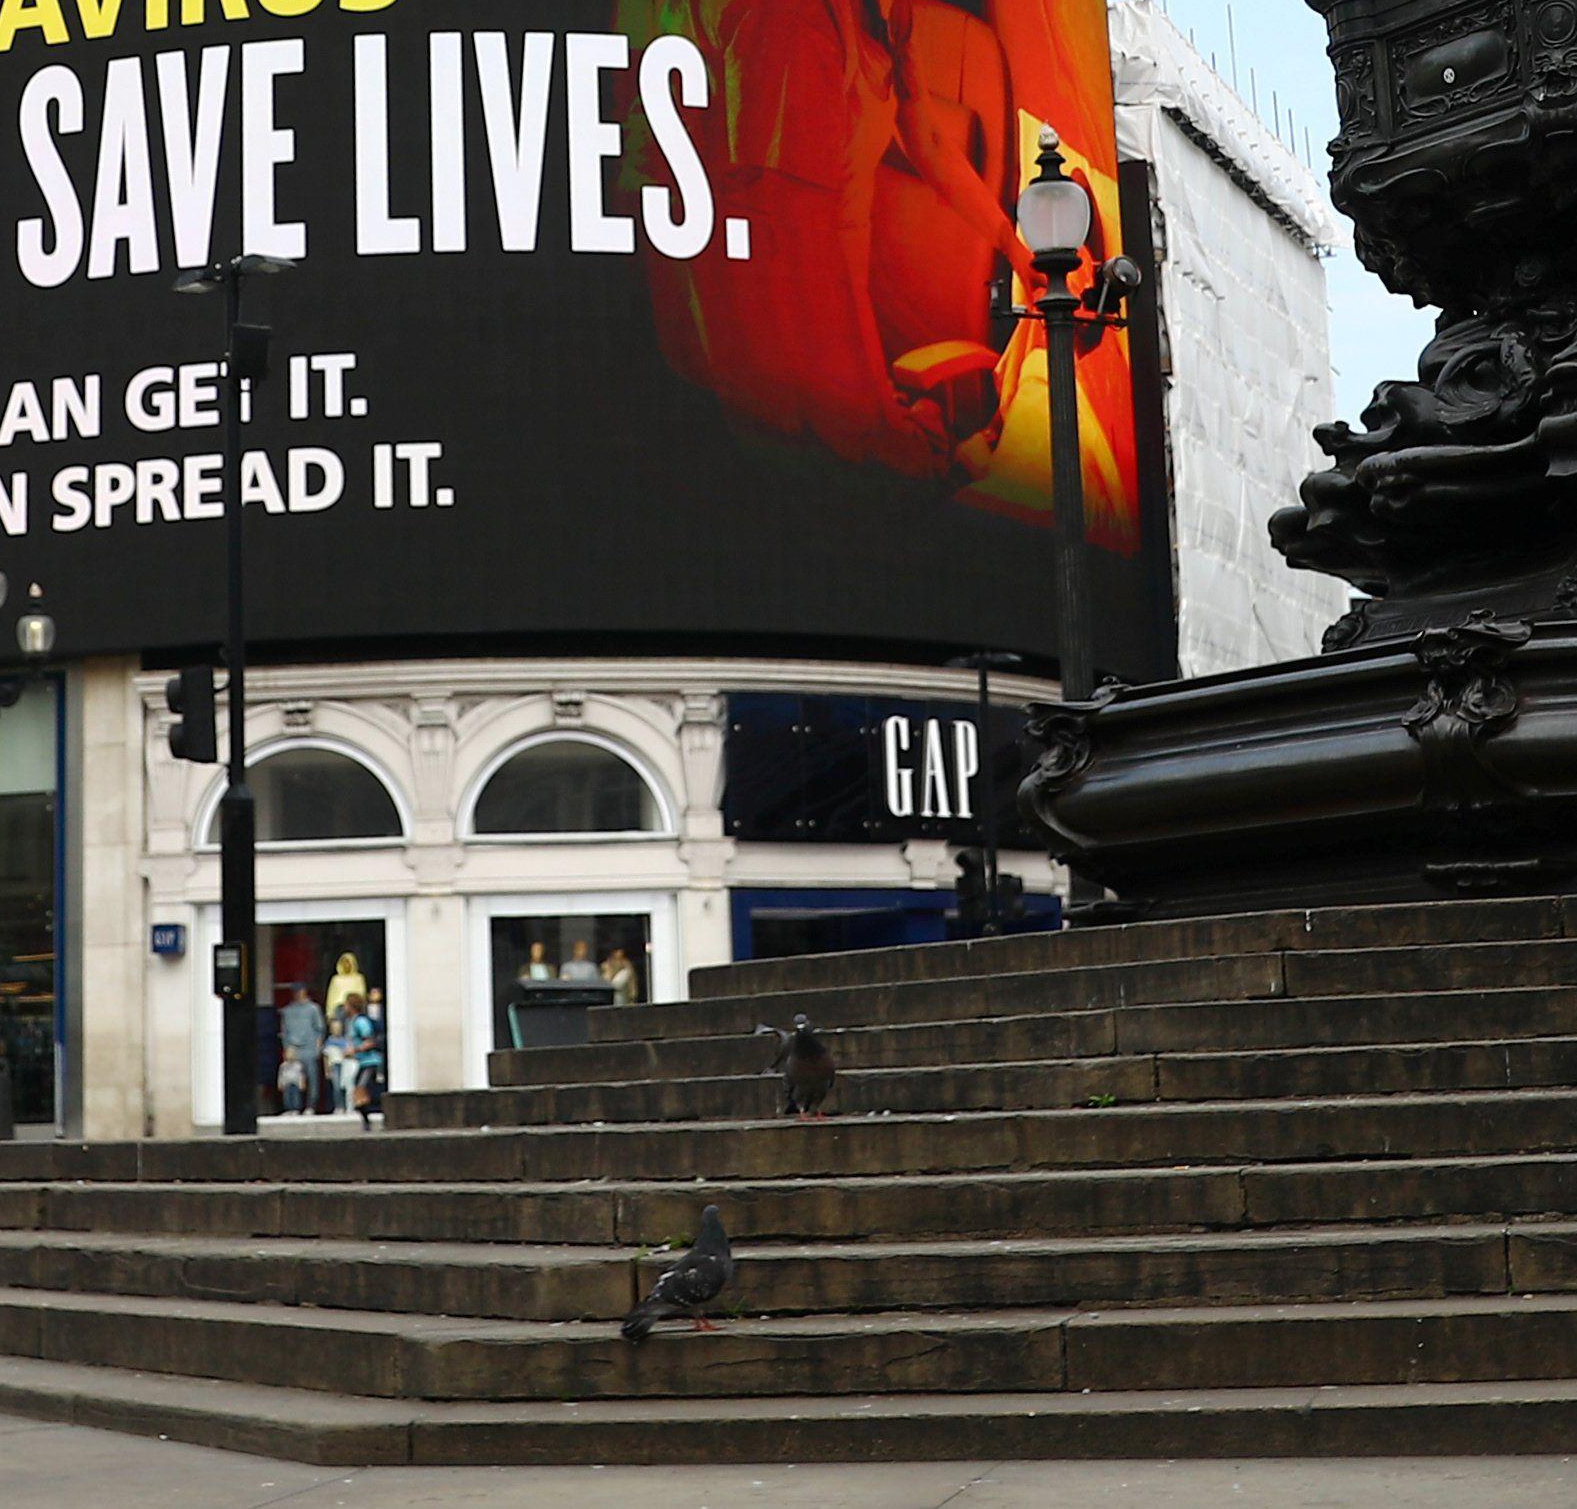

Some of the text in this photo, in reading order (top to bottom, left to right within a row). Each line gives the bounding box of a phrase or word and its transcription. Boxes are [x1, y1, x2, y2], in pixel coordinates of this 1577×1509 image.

[16, 36, 306, 288] SAVE
[354, 30, 751, 260] LIVES.
[289, 353, 369, 419] IT.
[52, 447, 344, 532] SPREAD
[372, 442, 455, 508] IT.
[884, 715, 979, 819] GAP
